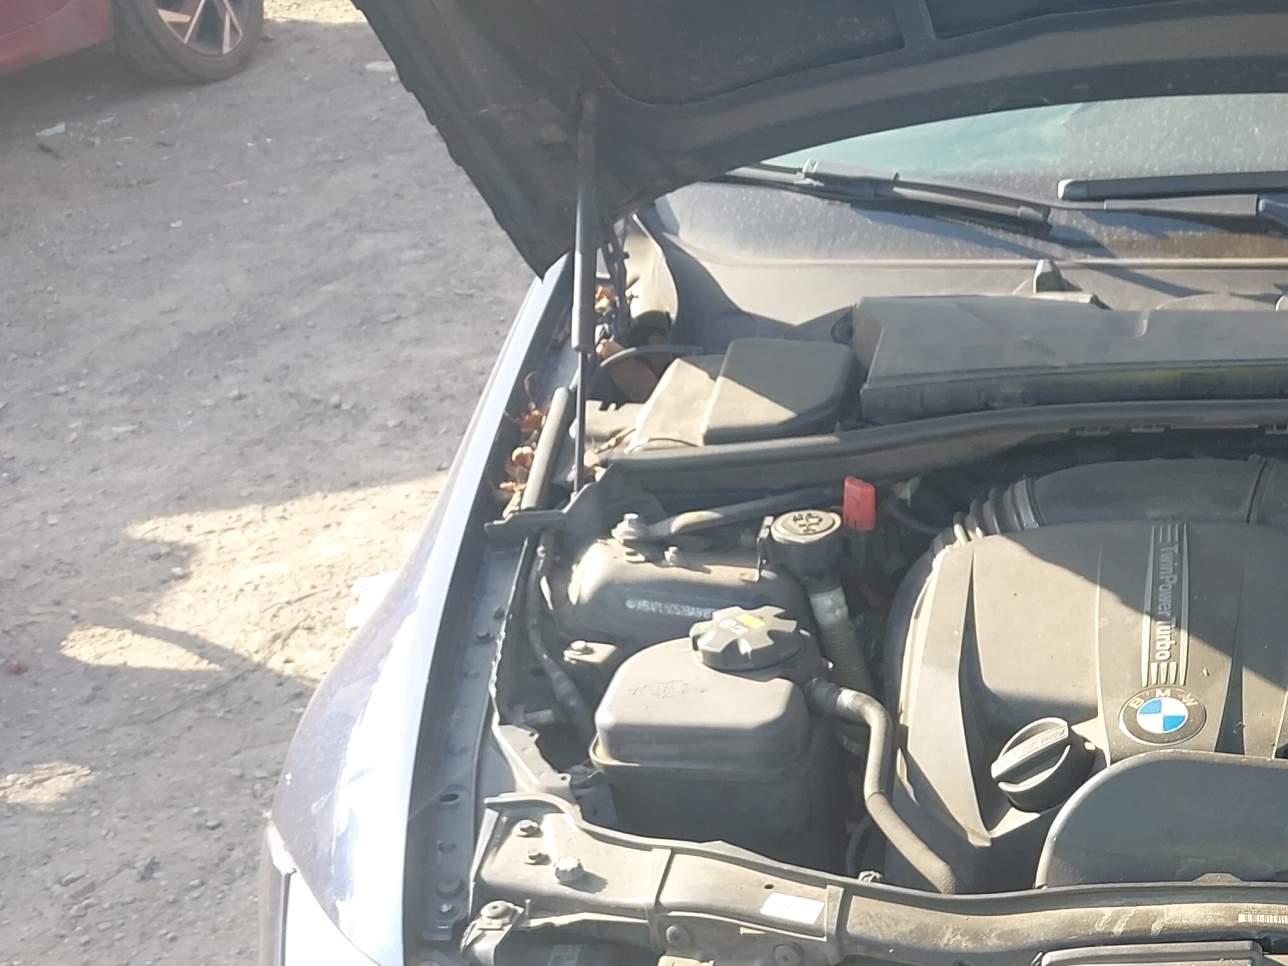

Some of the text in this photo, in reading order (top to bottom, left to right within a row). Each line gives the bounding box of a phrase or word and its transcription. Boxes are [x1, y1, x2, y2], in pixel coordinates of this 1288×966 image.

[1155, 543, 1180, 661] TwinPower Turbo
[1128, 687, 1199, 709] BMW
